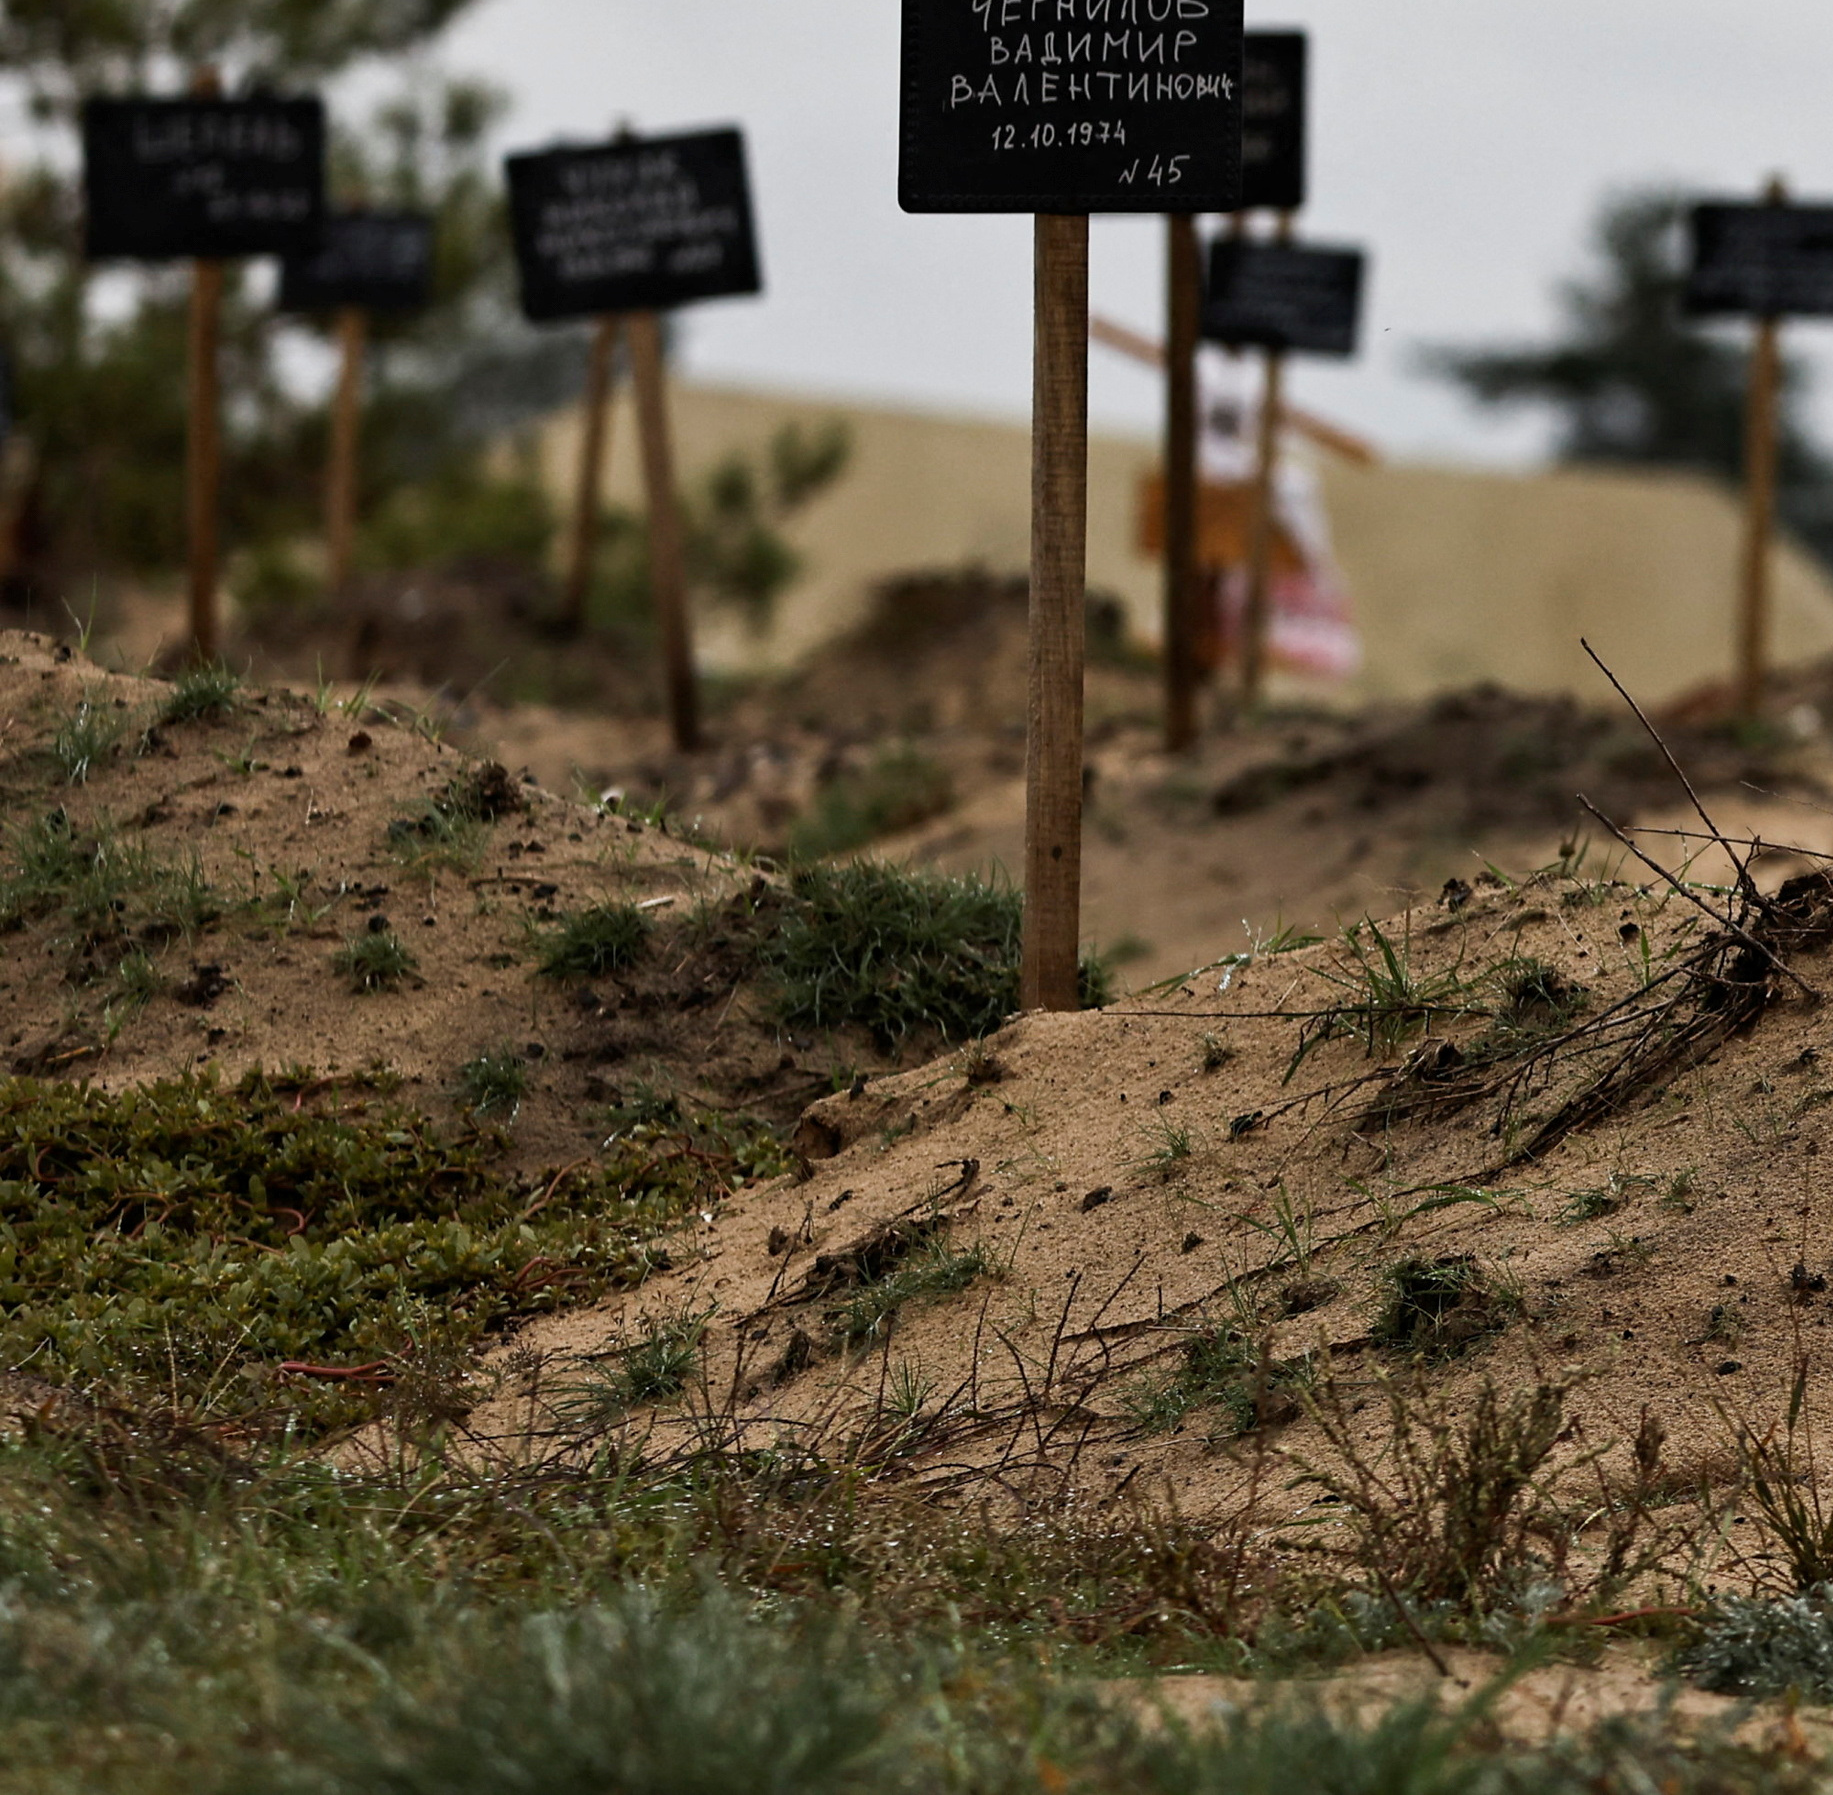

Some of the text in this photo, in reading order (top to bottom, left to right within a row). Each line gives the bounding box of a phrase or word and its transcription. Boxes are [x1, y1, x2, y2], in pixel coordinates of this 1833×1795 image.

[990, 29, 1198, 66] ВАДИМИР
[951, 71, 1235, 109] ВАЛЕНТИНОВИЧ
[991, 119, 1126, 151] 12.10.1974
